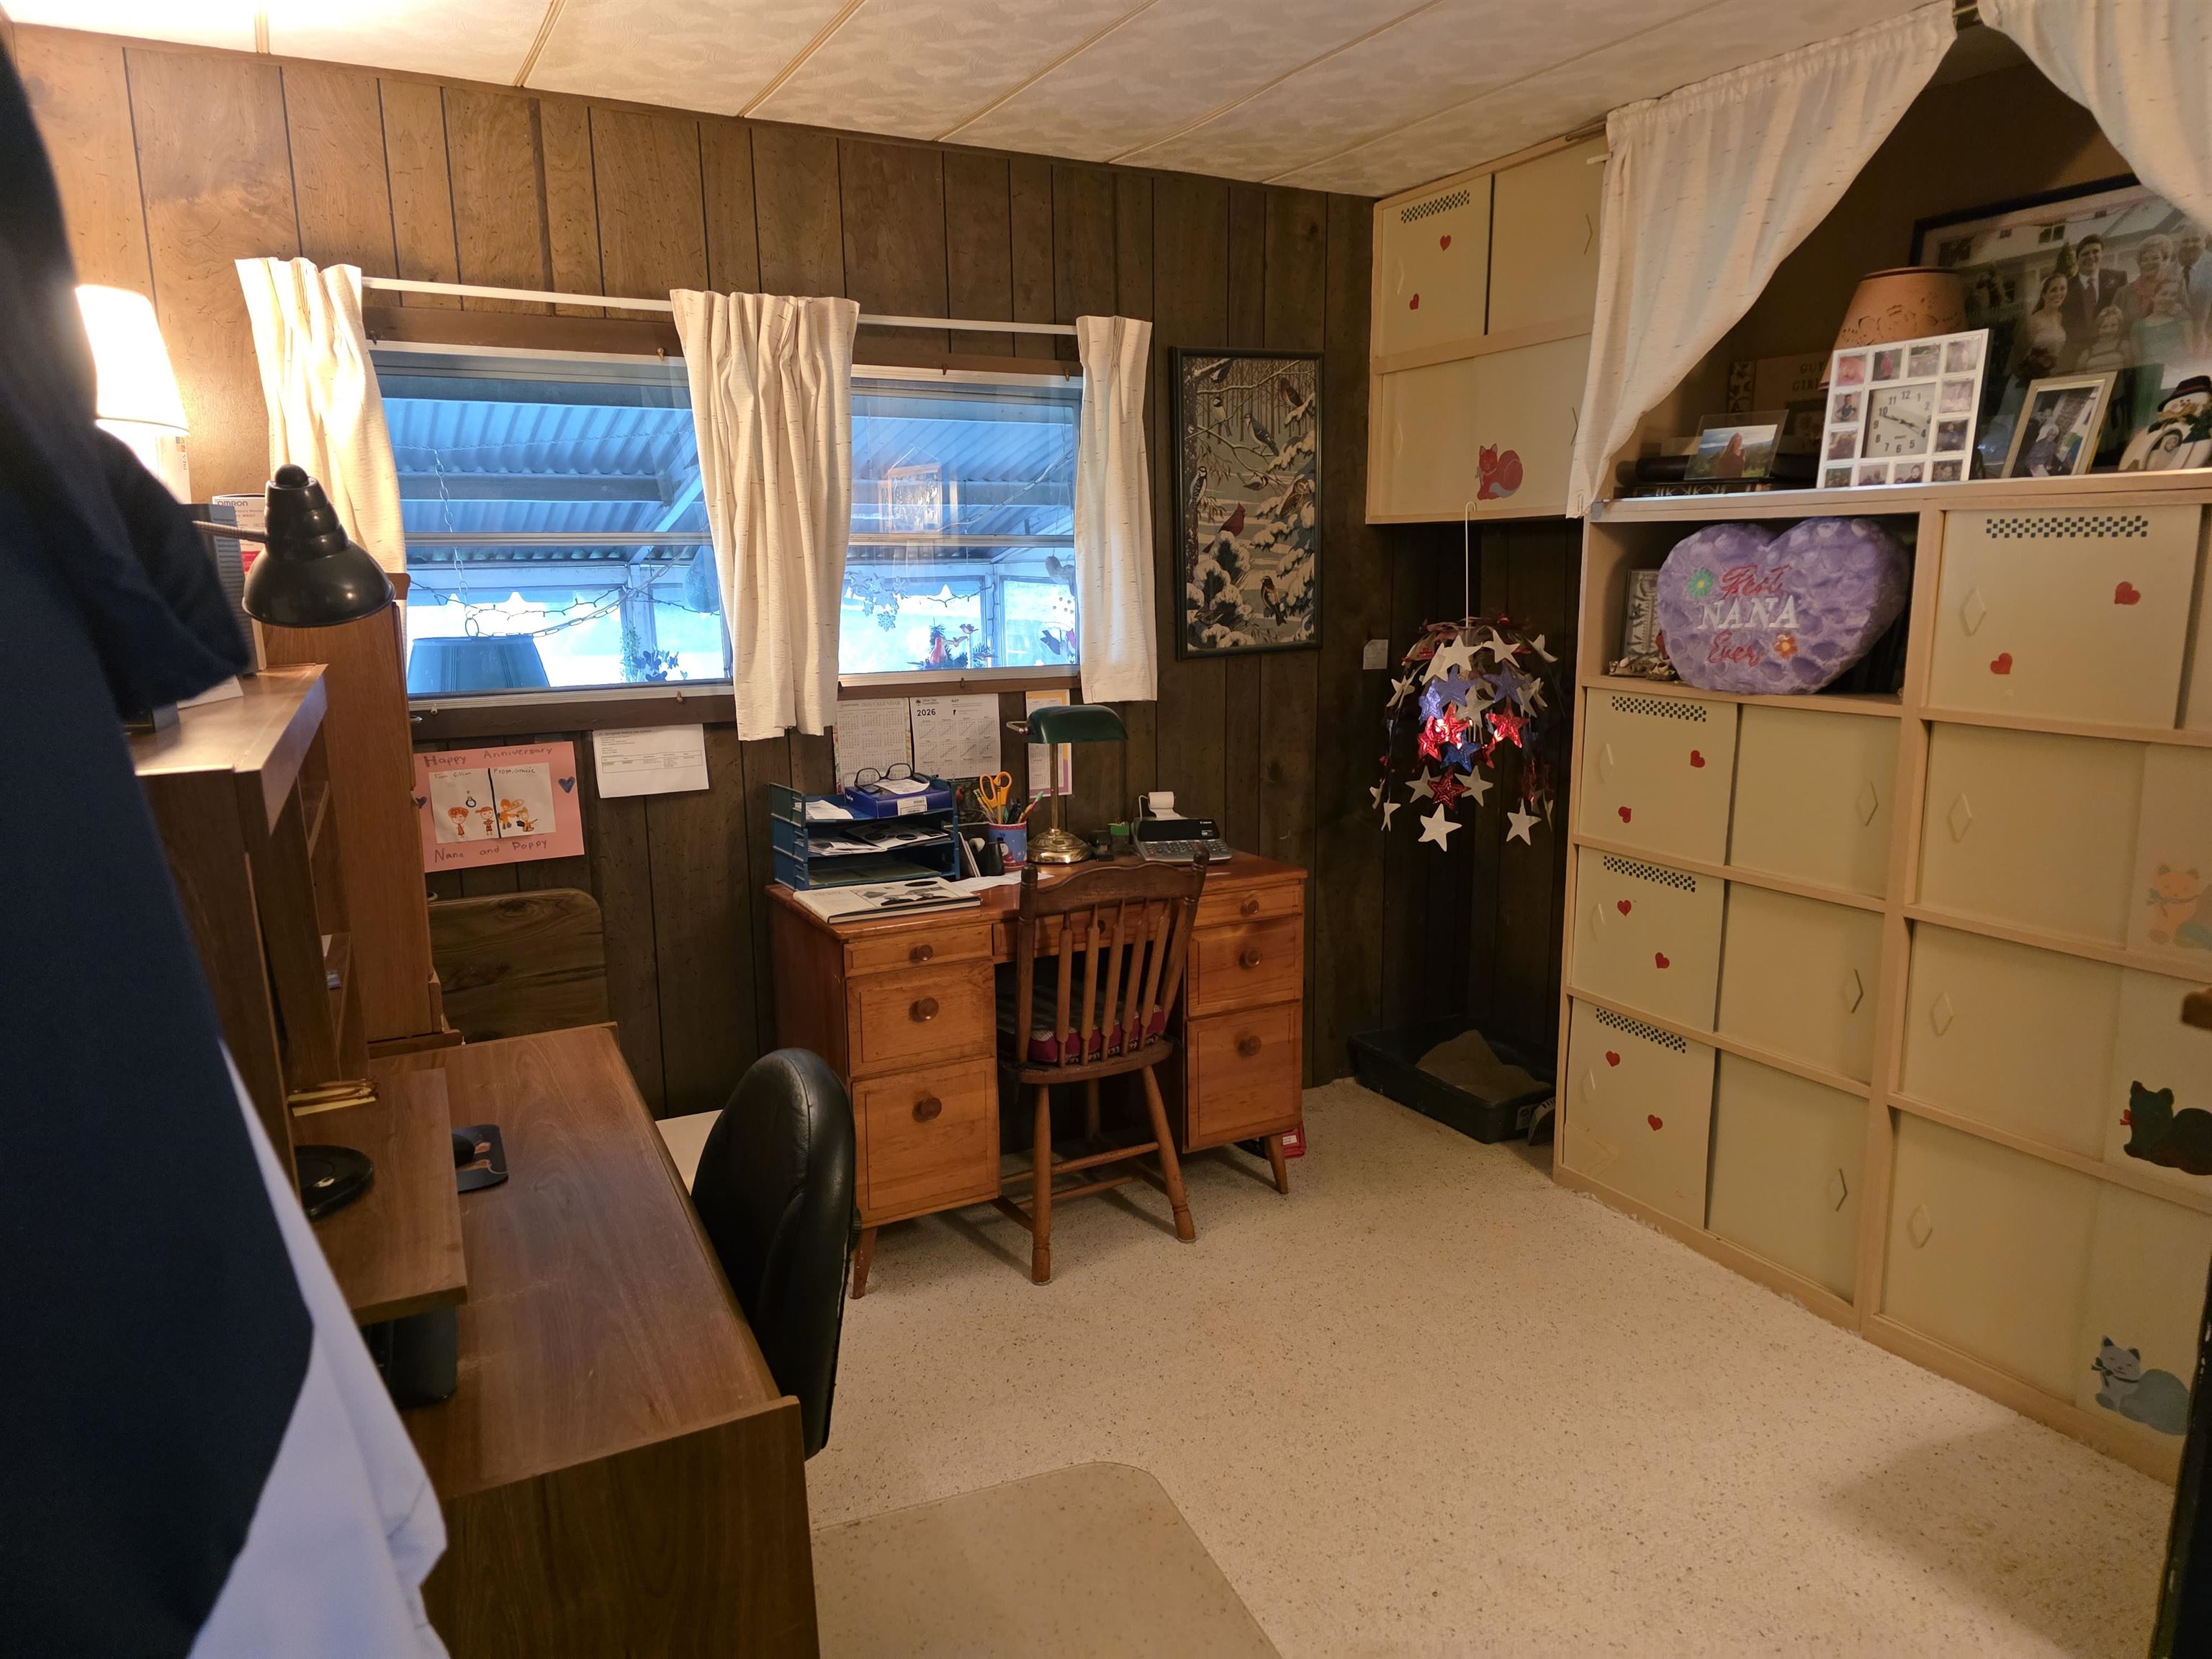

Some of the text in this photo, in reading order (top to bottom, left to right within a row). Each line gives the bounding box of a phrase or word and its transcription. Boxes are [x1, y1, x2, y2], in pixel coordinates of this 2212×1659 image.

[1889, 395, 1897, 405] 11
[1902, 390, 1911, 400] 12
[1917, 392, 1921, 402] 1
[1879, 406, 1888, 416] 10
[1924, 402, 1930, 410] 2
[1874, 420, 1879, 429] 9
[1876, 434, 1881, 443] 8
[1921, 429, 1926, 438] 4
[1884, 442, 1889, 451] 7
[1896, 444, 1901, 453] 6
[1909, 440, 1915, 449] 5
[1696, 594, 1800, 631] NANA
[1707, 631, 1764, 668] Ever
[424, 747, 553, 768] Happy Anniversary
[434, 840, 547, 863] Nana and Poppy
